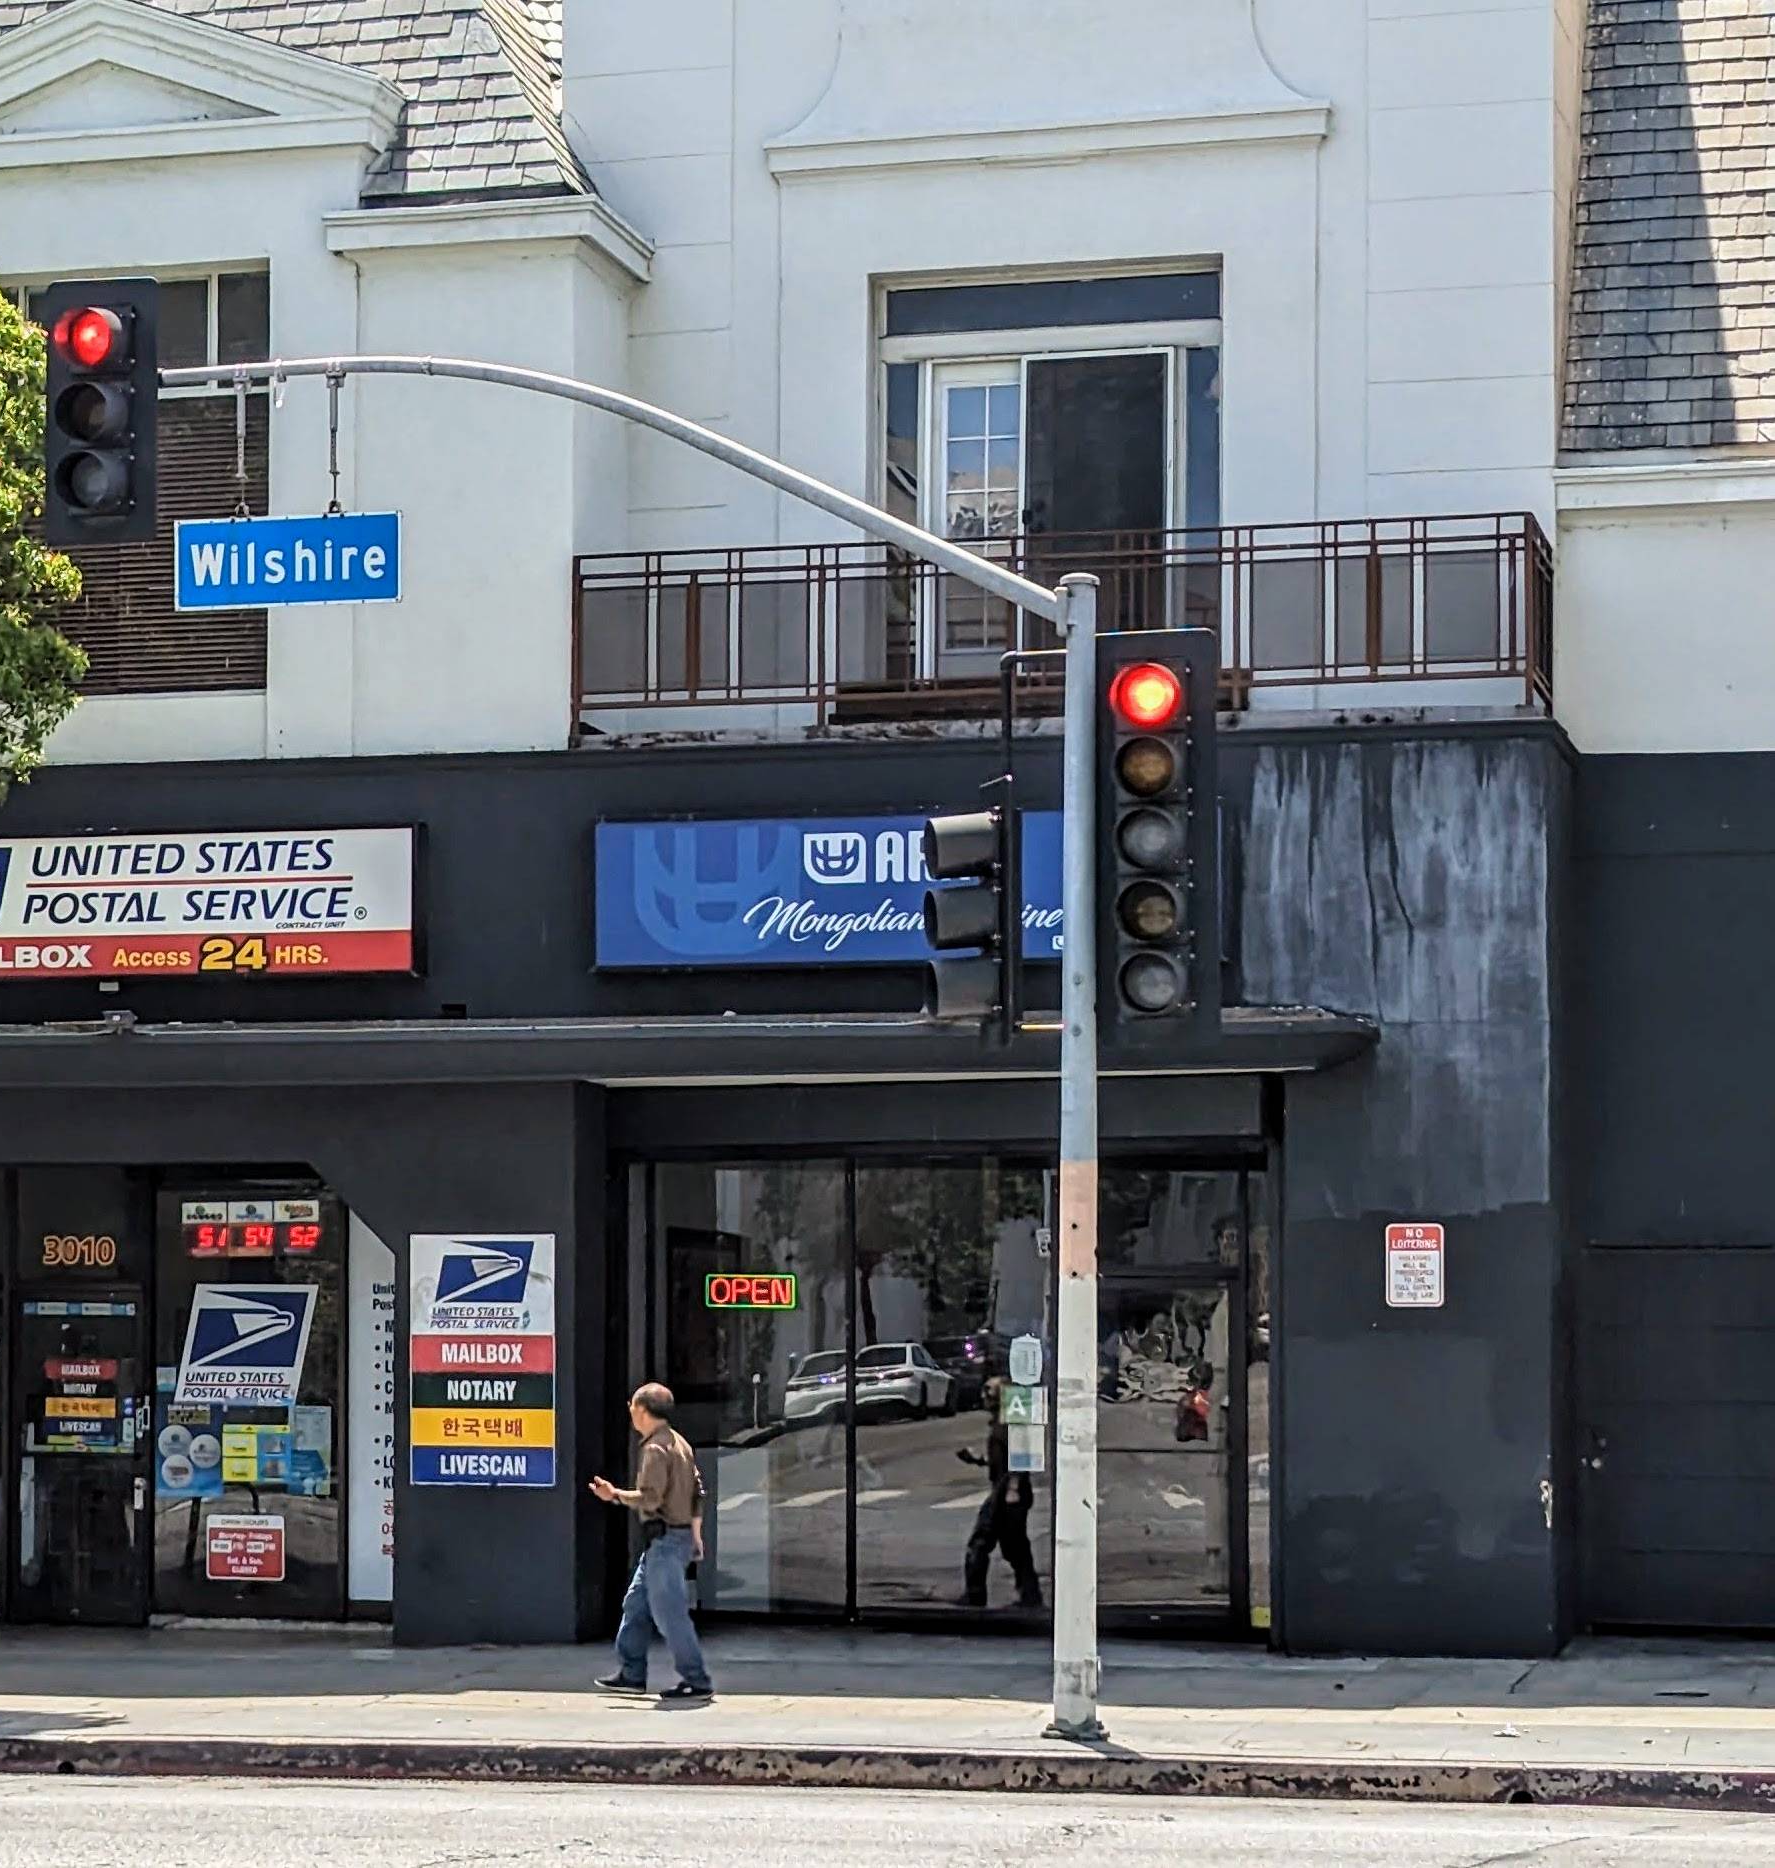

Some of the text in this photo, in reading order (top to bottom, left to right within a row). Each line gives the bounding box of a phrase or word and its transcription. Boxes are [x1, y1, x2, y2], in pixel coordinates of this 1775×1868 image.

[191, 540, 386, 586] Wilshire
[32, 839, 334, 877] UNITED STATES
[23, 887, 353, 924] POSTAL SERVICE
[275, 922, 322, 930] CONTRACT
[743, 896, 925, 951] Mongolian
[112, 947, 192, 967] Access
[200, 937, 267, 972] 24
[274, 946, 329, 965] HRS.
[245, 1227, 274, 1246] 54
[289, 1226, 319, 1246] 52
[1406, 1229, 1423, 1238] NO
[43, 1235, 116, 1265] 3010
[1391, 1239, 1438, 1249] LOITERING
[710, 1278, 791, 1304] OPEN
[432, 1307, 514, 1316] UNITED STATES
[430, 1320, 520, 1328] POSTAL SERVICE
[441, 1343, 523, 1364] MAILBOX
[61, 1365, 101, 1375] MAILBOX
[185, 1372, 285, 1384] UNITED STATES
[183, 1387, 290, 1399] POSTAL SERVICE
[447, 1380, 517, 1400] NOTARY
[1008, 1396, 1026, 1417] A
[60, 1421, 102, 1432] LIVESCAN
[442, 1417, 523, 1438] 한국택배
[440, 1455, 526, 1476] LIVESCAN
